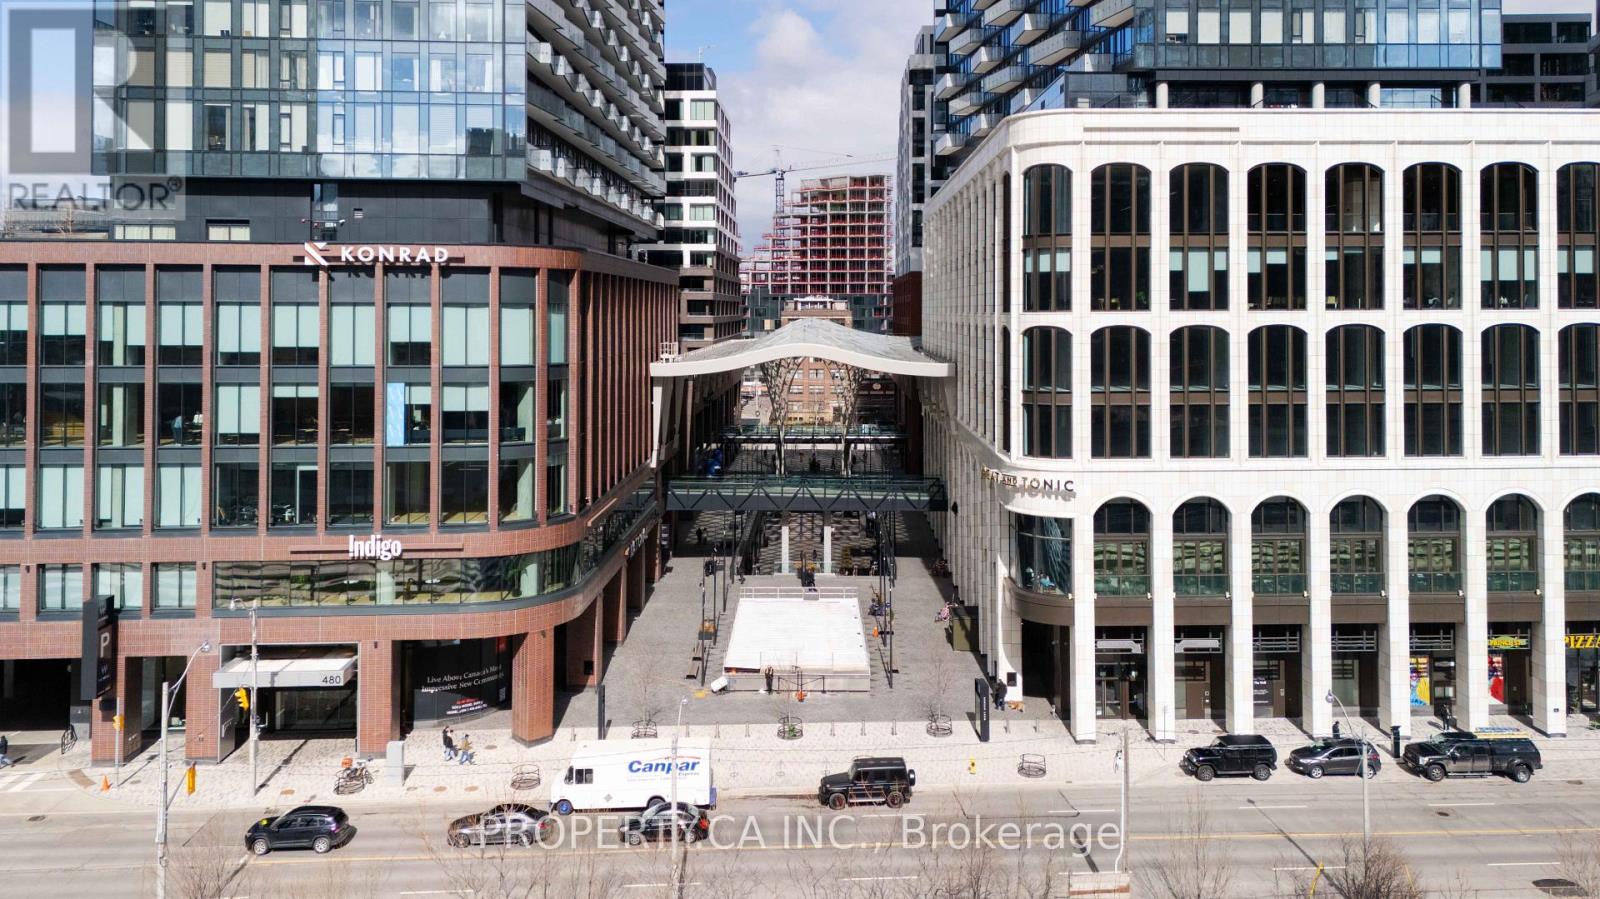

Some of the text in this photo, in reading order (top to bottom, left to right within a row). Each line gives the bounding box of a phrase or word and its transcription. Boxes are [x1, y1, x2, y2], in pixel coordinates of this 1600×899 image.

[341, 246, 449, 263] KONRAD
[1022, 477, 1074, 492] TONIC
[100, 632, 110, 658] P
[322, 675, 341, 685] 480
[427, 676, 441, 684] Live
[628, 760, 700, 774] Canpar
